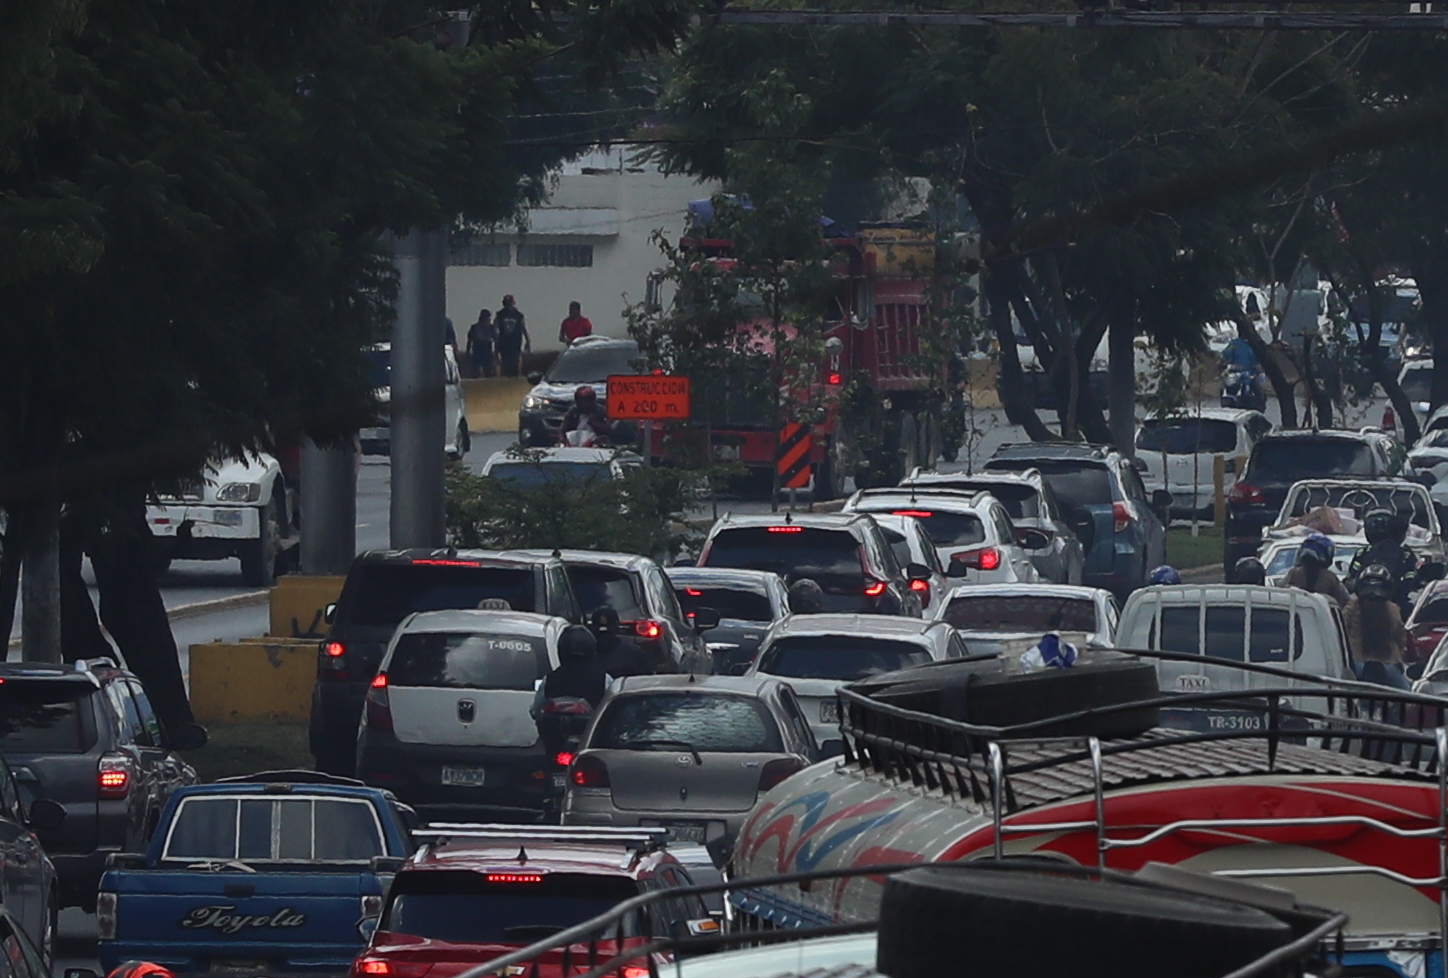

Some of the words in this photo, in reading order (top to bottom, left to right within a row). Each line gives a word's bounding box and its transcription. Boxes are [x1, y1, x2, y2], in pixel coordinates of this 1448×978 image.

[617, 401, 625, 412] A
[1179, 678, 1208, 688] TAXI
[182, 905, 305, 934] Toyota
